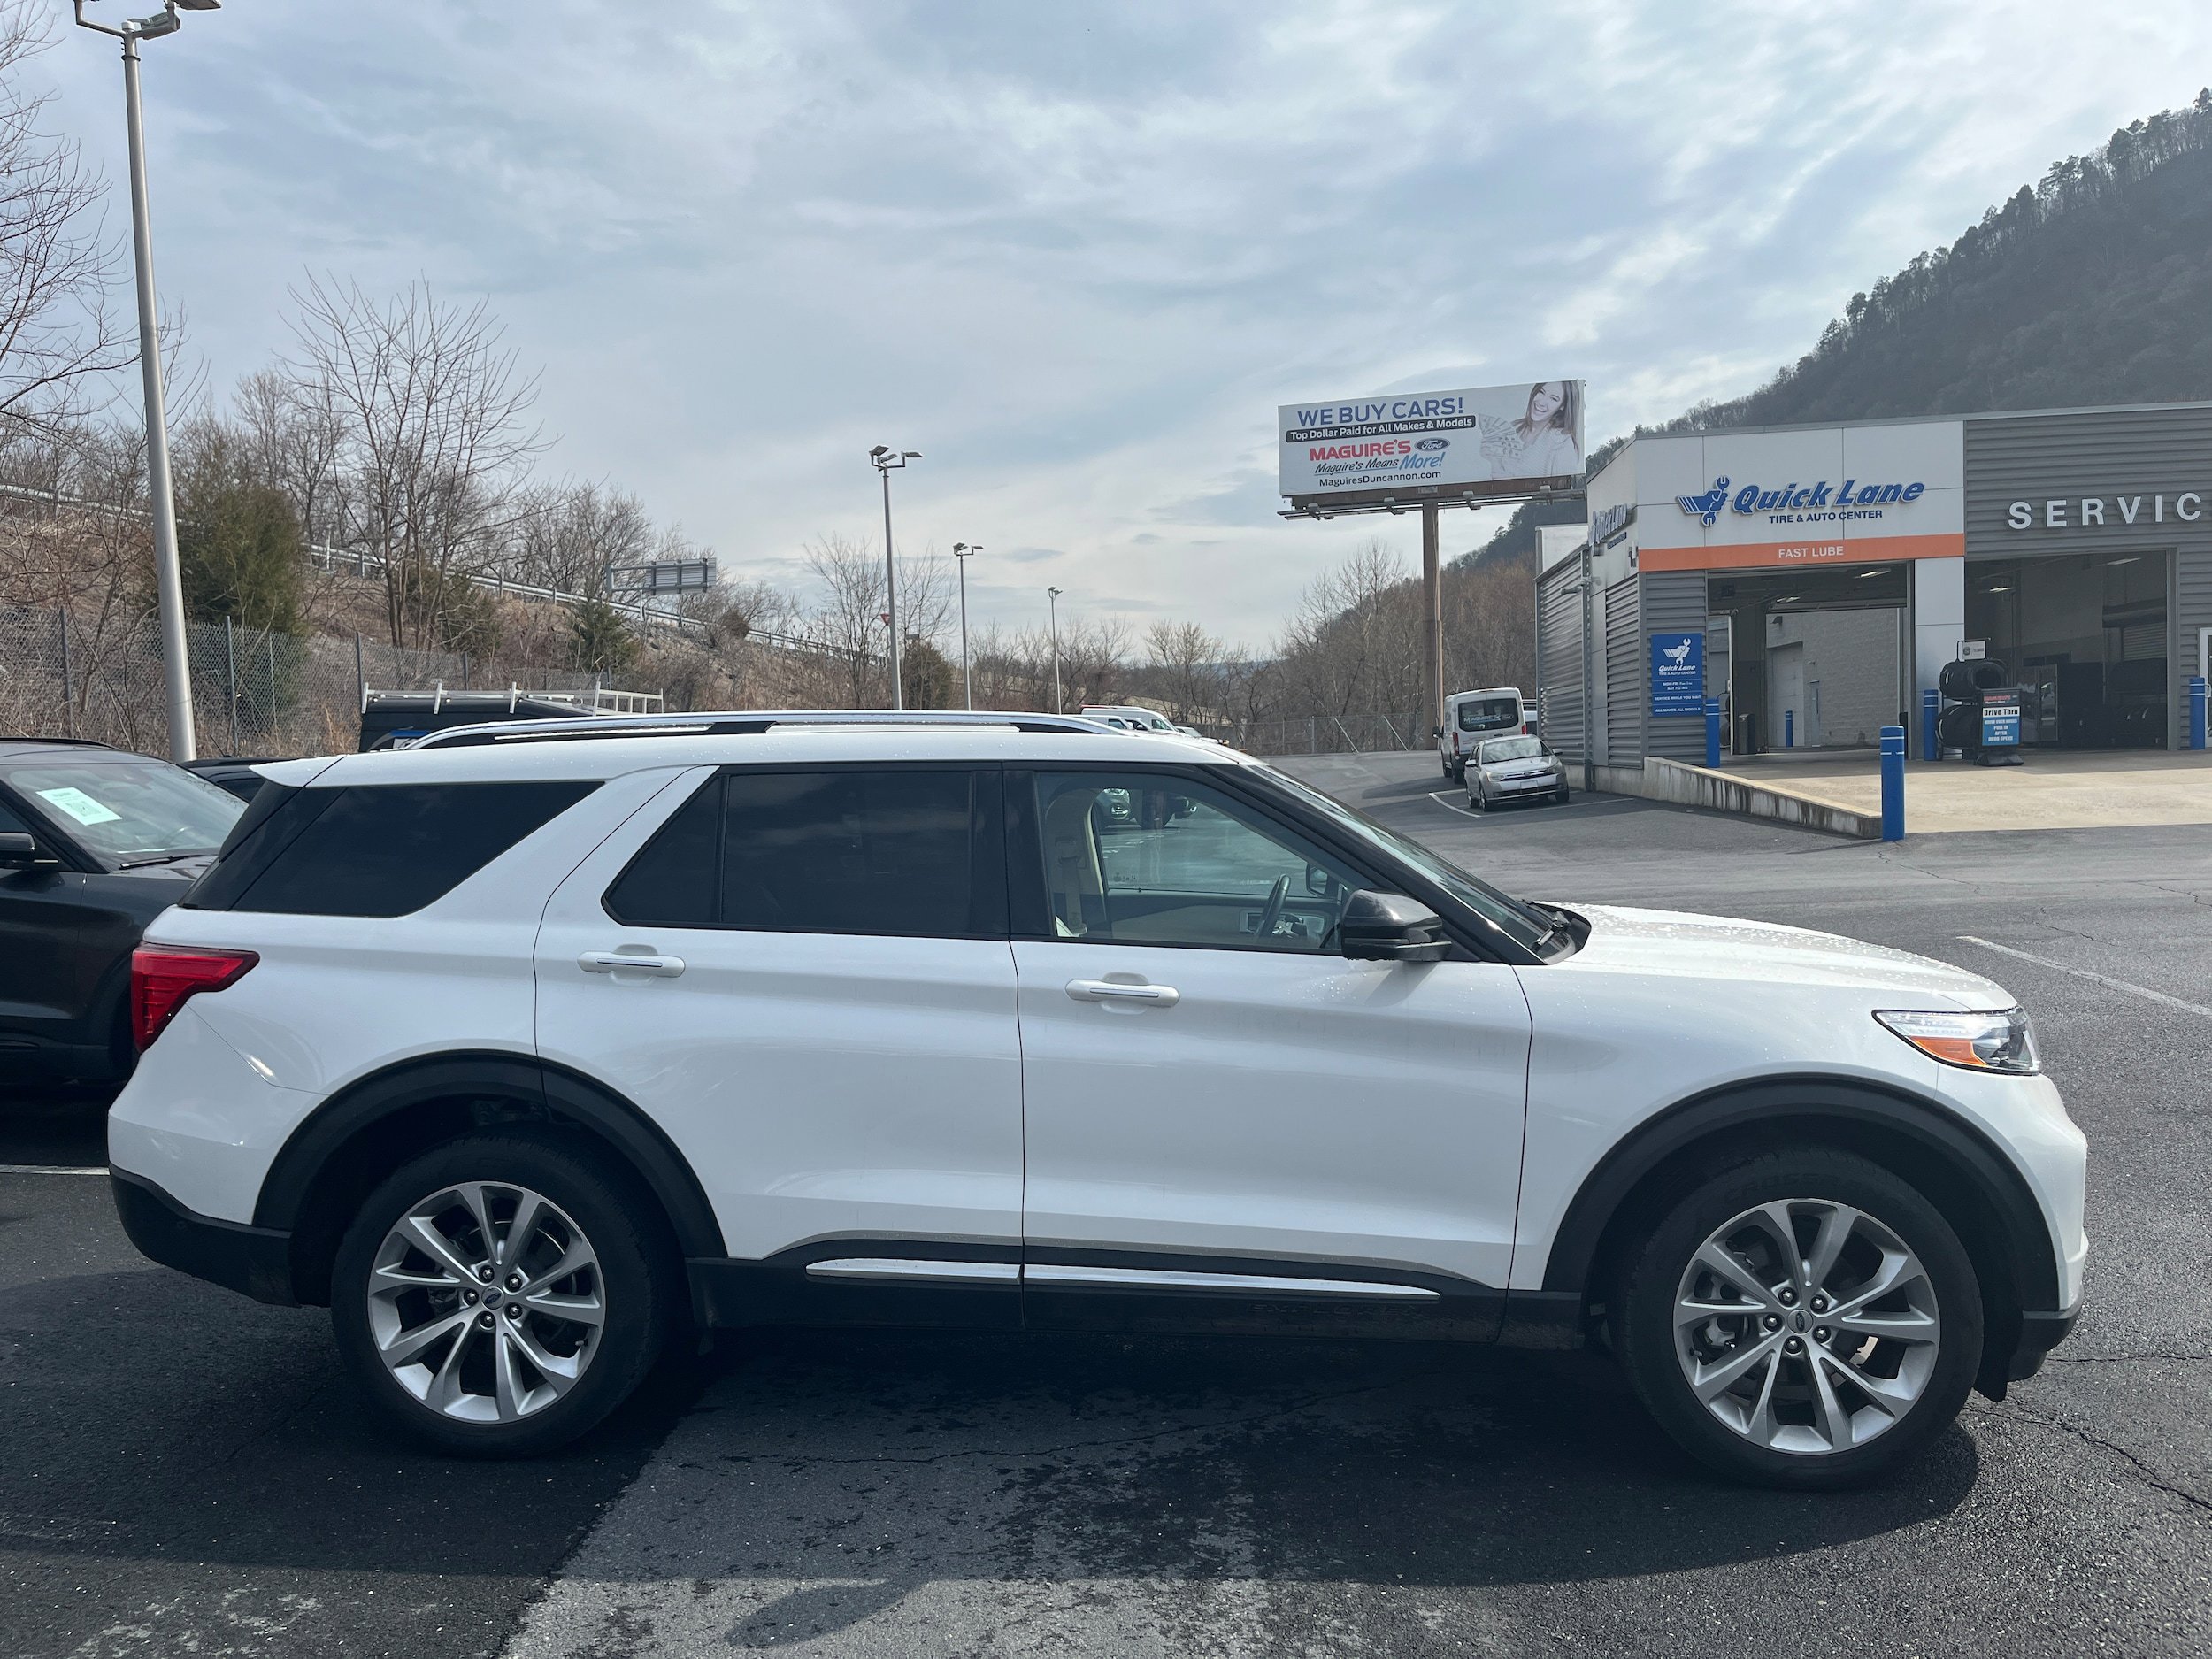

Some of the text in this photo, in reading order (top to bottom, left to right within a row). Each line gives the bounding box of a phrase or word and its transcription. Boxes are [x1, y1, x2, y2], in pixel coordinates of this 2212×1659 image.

[1297, 397, 1463, 426] WE BUY CARS!
[1290, 417, 1472, 441] Top Dollar Paid for All Makes & Models
[1310, 439, 1411, 461] MAGUIRE'S
[1315, 451, 1446, 476] Maguire's Means More!
[1319, 471, 1441, 488] MaguiresDuncannon.com
[1732, 480, 1925, 514] Quick Lane
[1769, 510, 1884, 524] TIRE & AUTO CENTER
[2008, 492, 2201, 530] SERVIC
[1778, 546, 1845, 558] FAST LUBE
